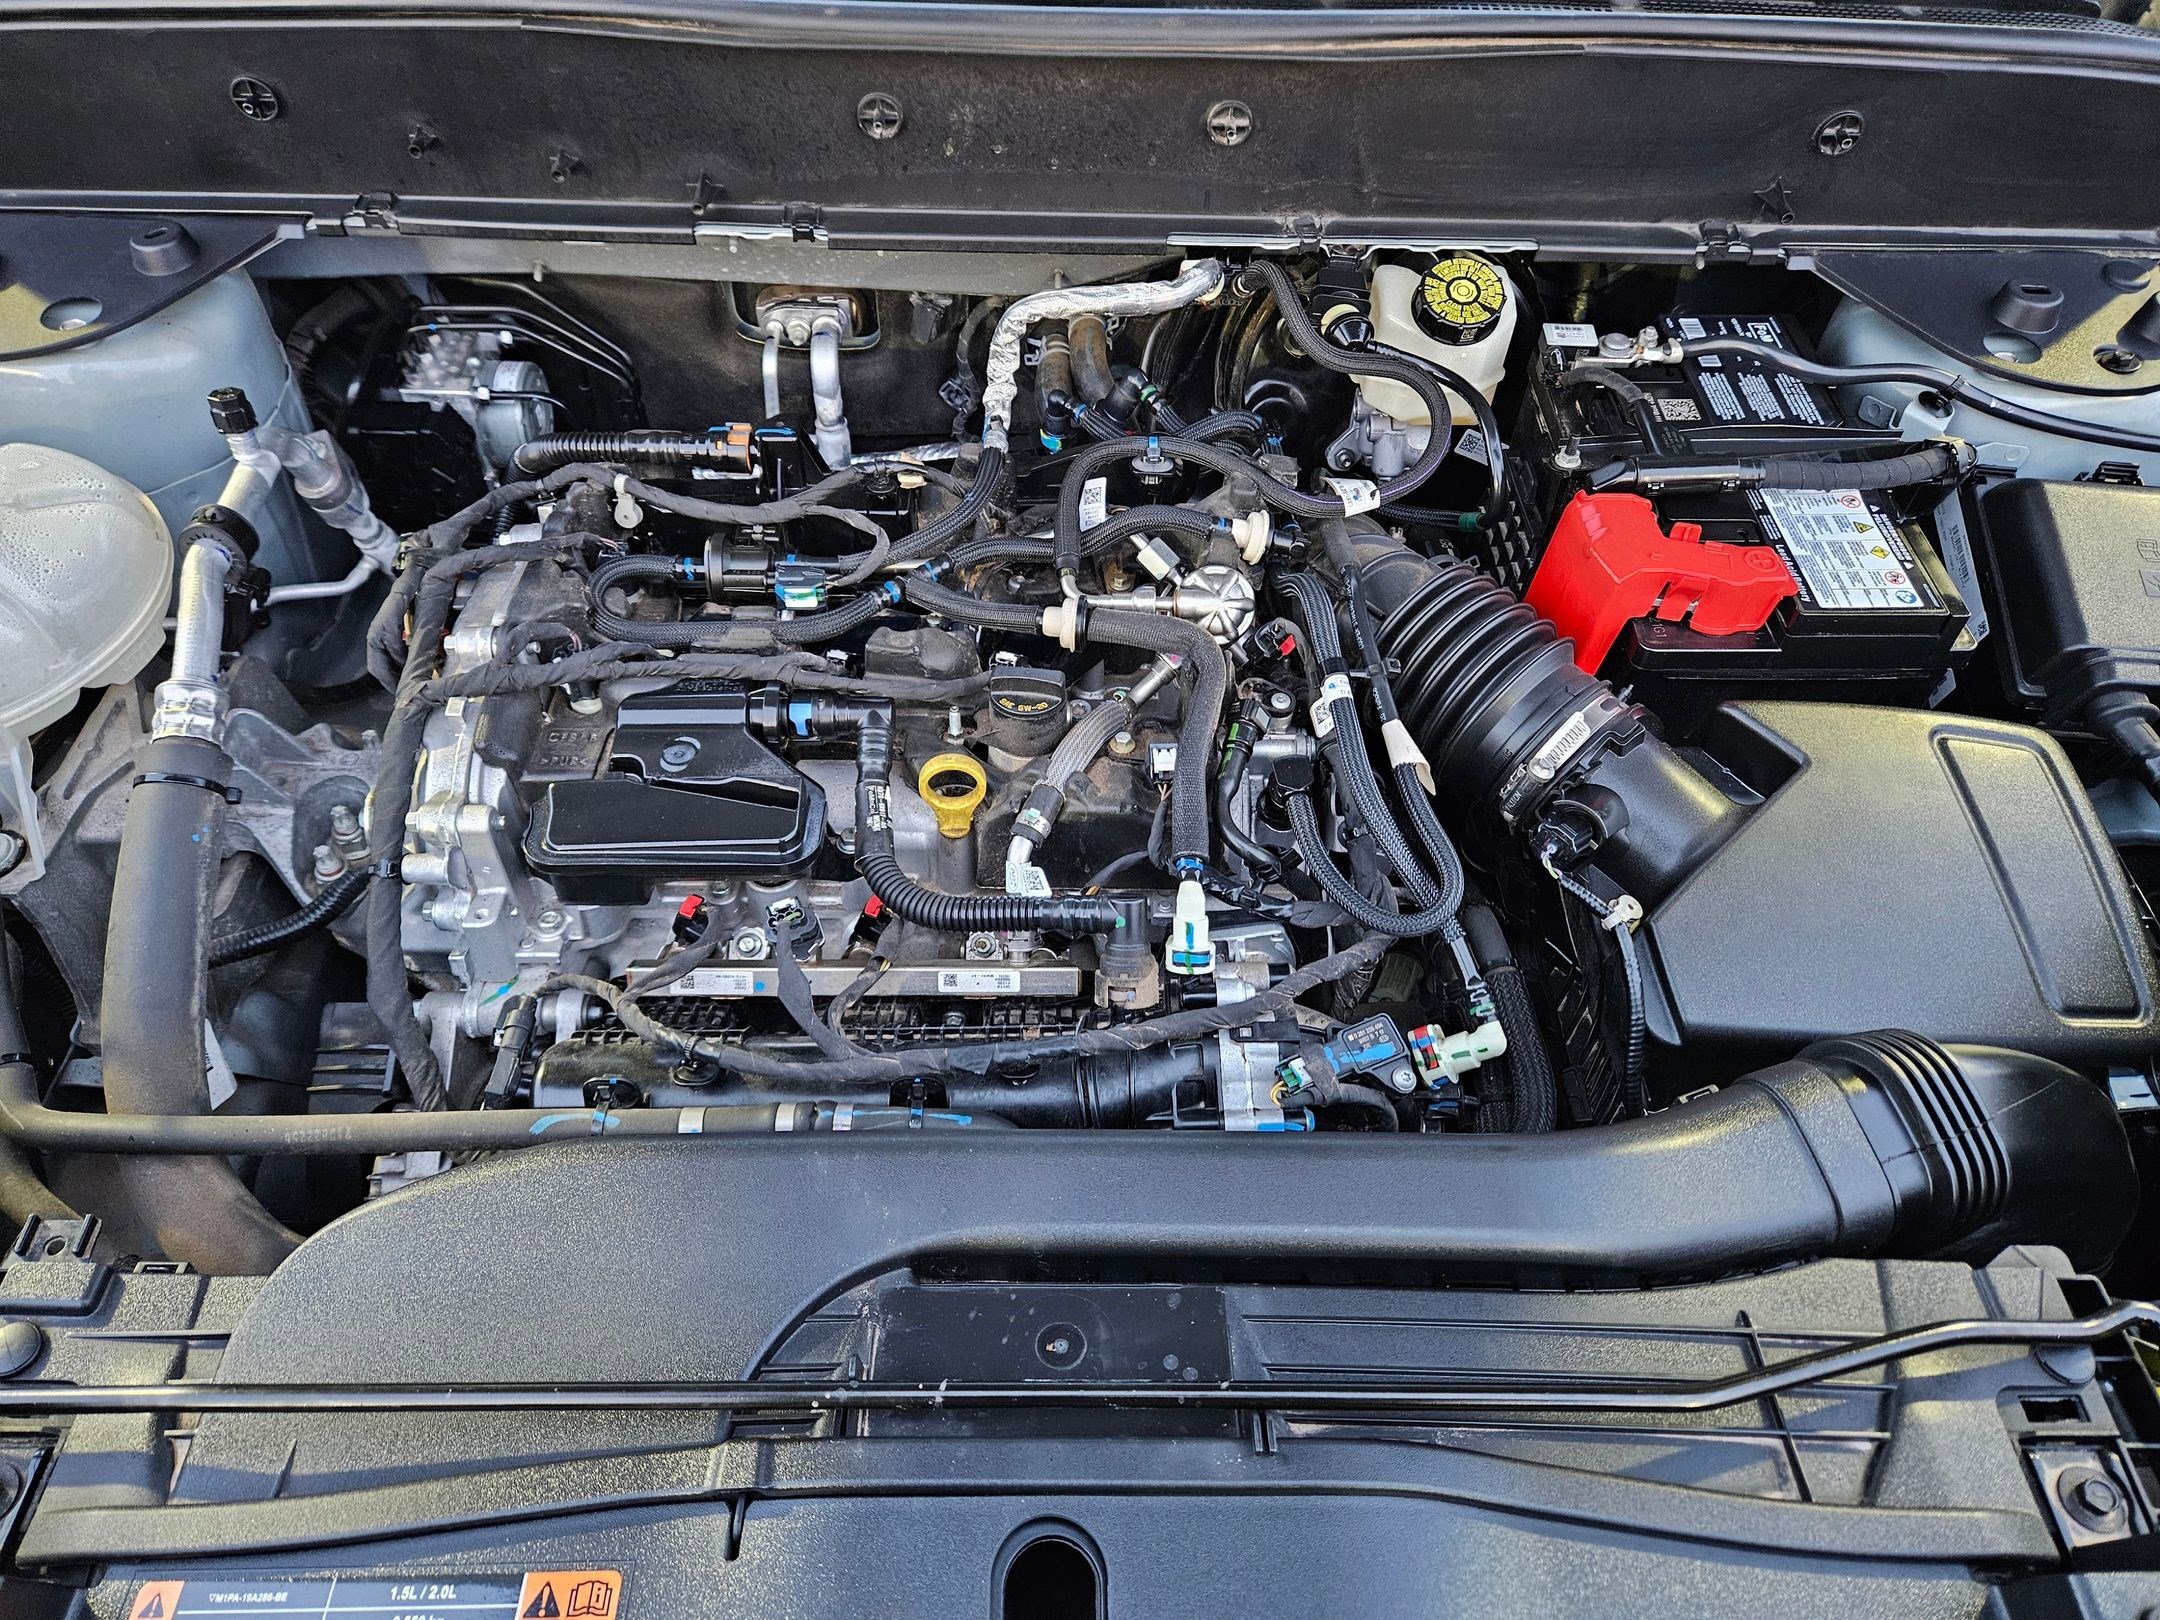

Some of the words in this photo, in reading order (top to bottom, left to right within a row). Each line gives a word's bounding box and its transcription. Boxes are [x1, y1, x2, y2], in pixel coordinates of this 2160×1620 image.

[1784, 561, 1800, 577] Acid
[391, 1585, 418, 1600] 1.5L
[419, 1584, 428, 1600] /
[428, 1584, 457, 1600] 2.0L
